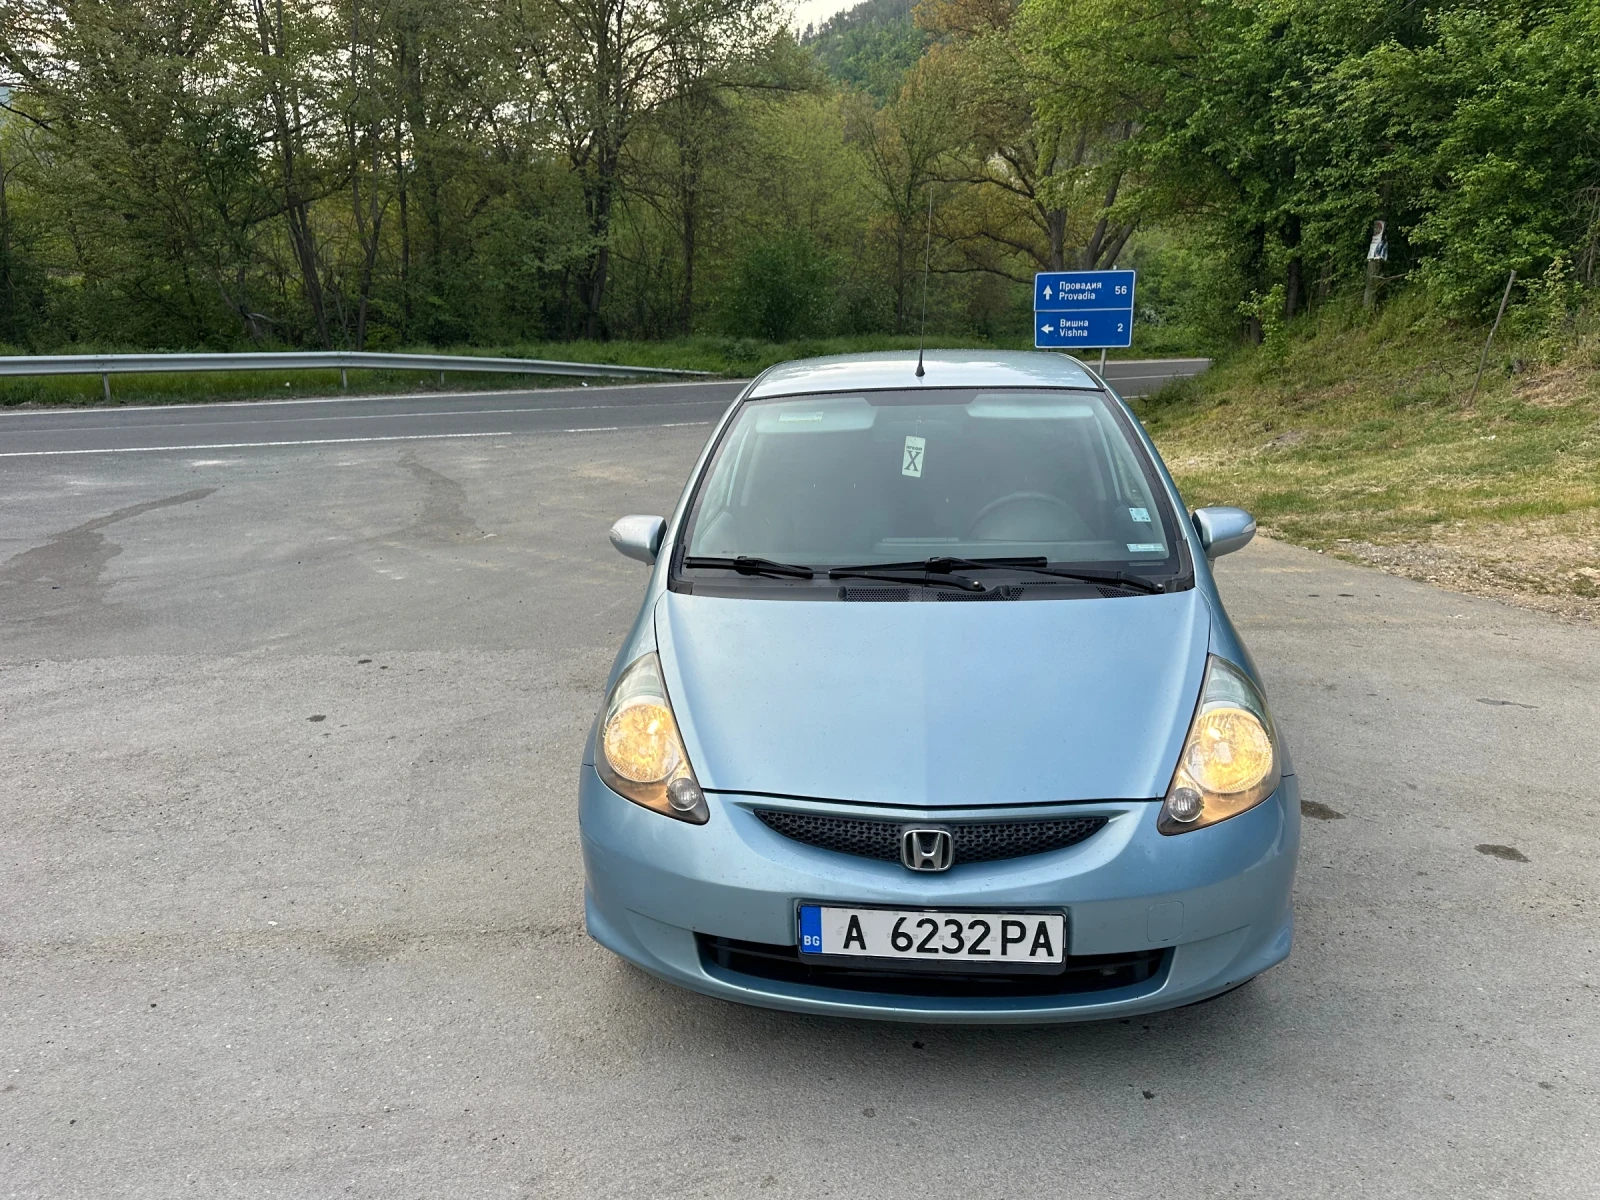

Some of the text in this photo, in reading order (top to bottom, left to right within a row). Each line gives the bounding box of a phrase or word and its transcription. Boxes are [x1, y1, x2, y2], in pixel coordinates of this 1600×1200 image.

[1059, 281, 1102, 291] Провадия
[1114, 286, 1127, 295] 56
[1058, 291, 1096, 300] Provadia
[1060, 319, 1089, 327] Вишна
[1117, 323, 1124, 332] 2
[1059, 328, 1088, 337] Vishna
[904, 450, 921, 472] X
[843, 914, 867, 950] A
[804, 935, 820, 946] BG
